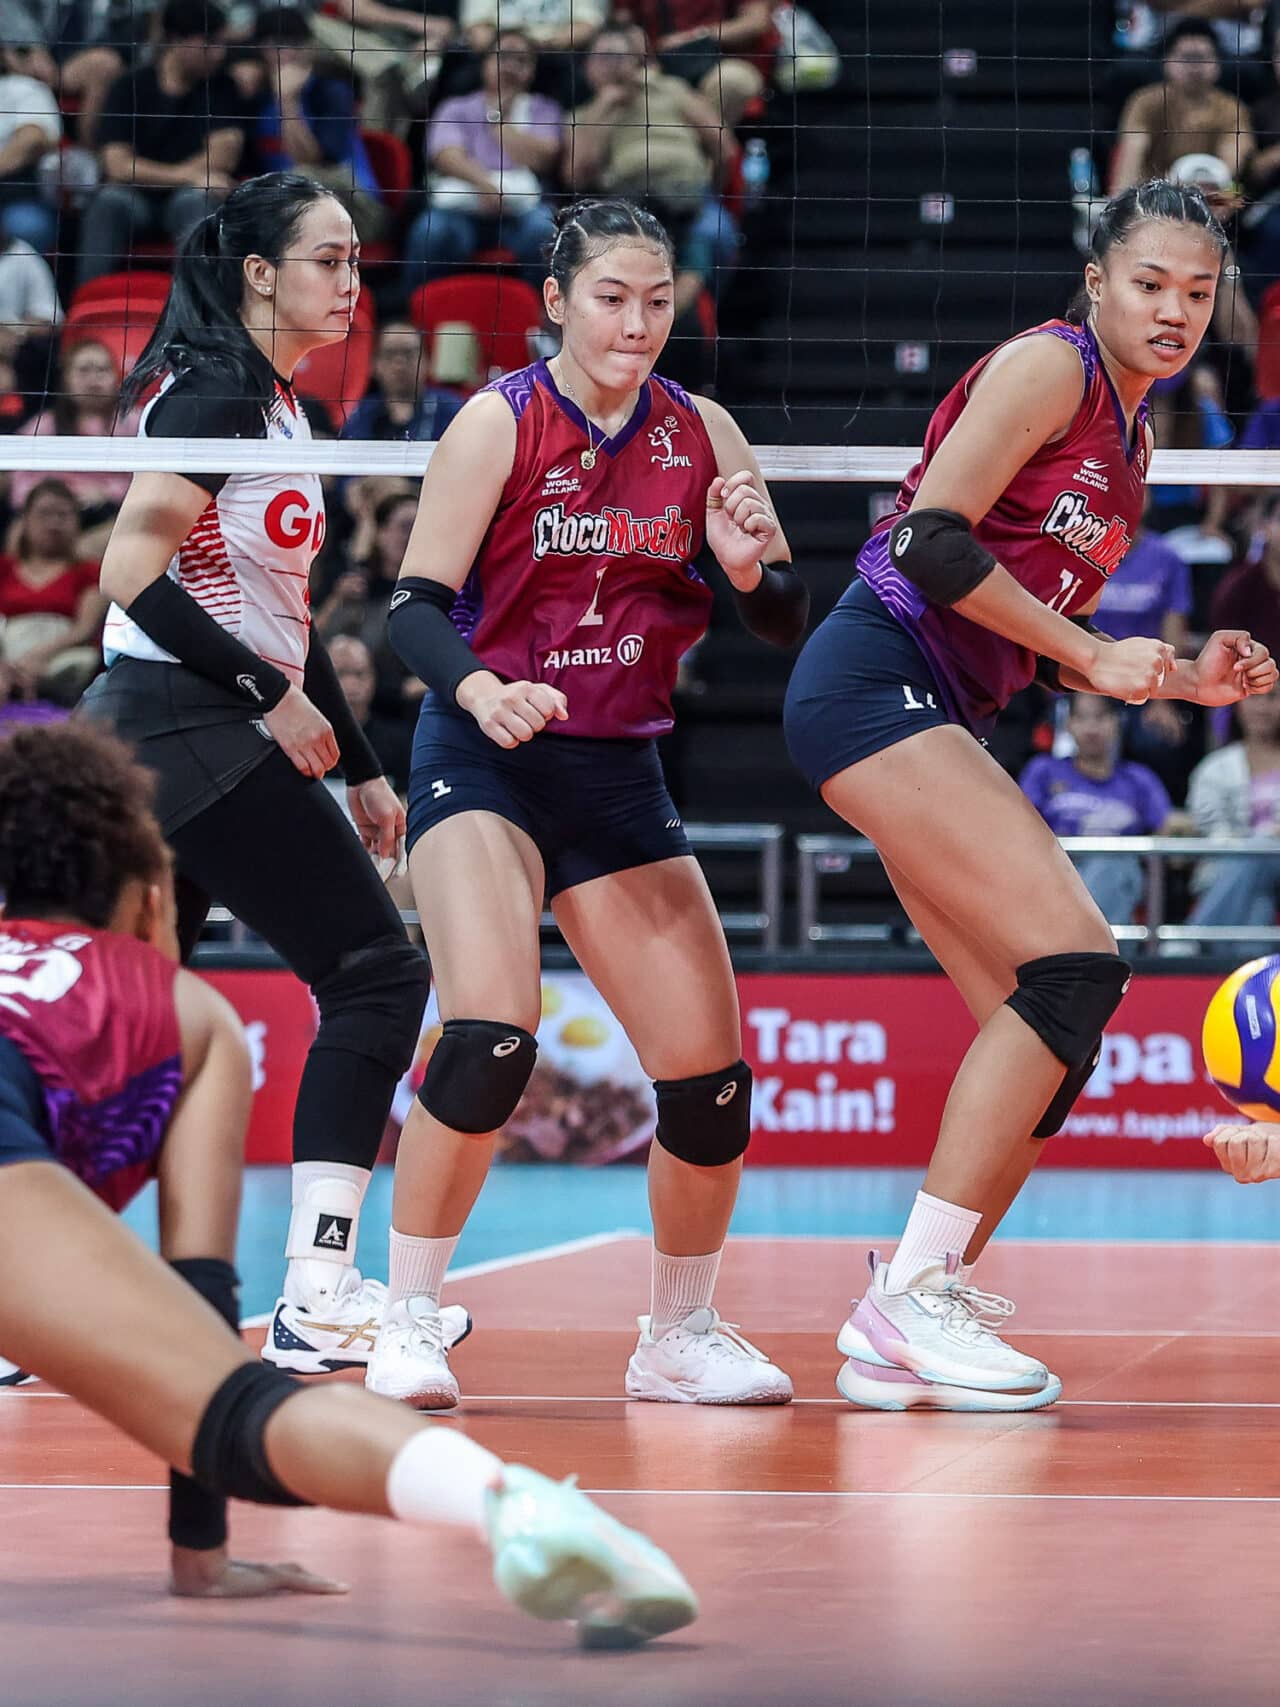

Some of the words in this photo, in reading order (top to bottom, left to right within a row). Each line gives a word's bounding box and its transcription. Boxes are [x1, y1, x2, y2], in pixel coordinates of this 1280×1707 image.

[545, 478, 579, 489] WORLD
[1072, 472, 1109, 492] BALANCE
[1079, 467, 1109, 484] WORLD
[577, 566, 609, 626] 1
[747, 1008, 888, 1064] Tara
[751, 1072, 897, 1133] Kain!
